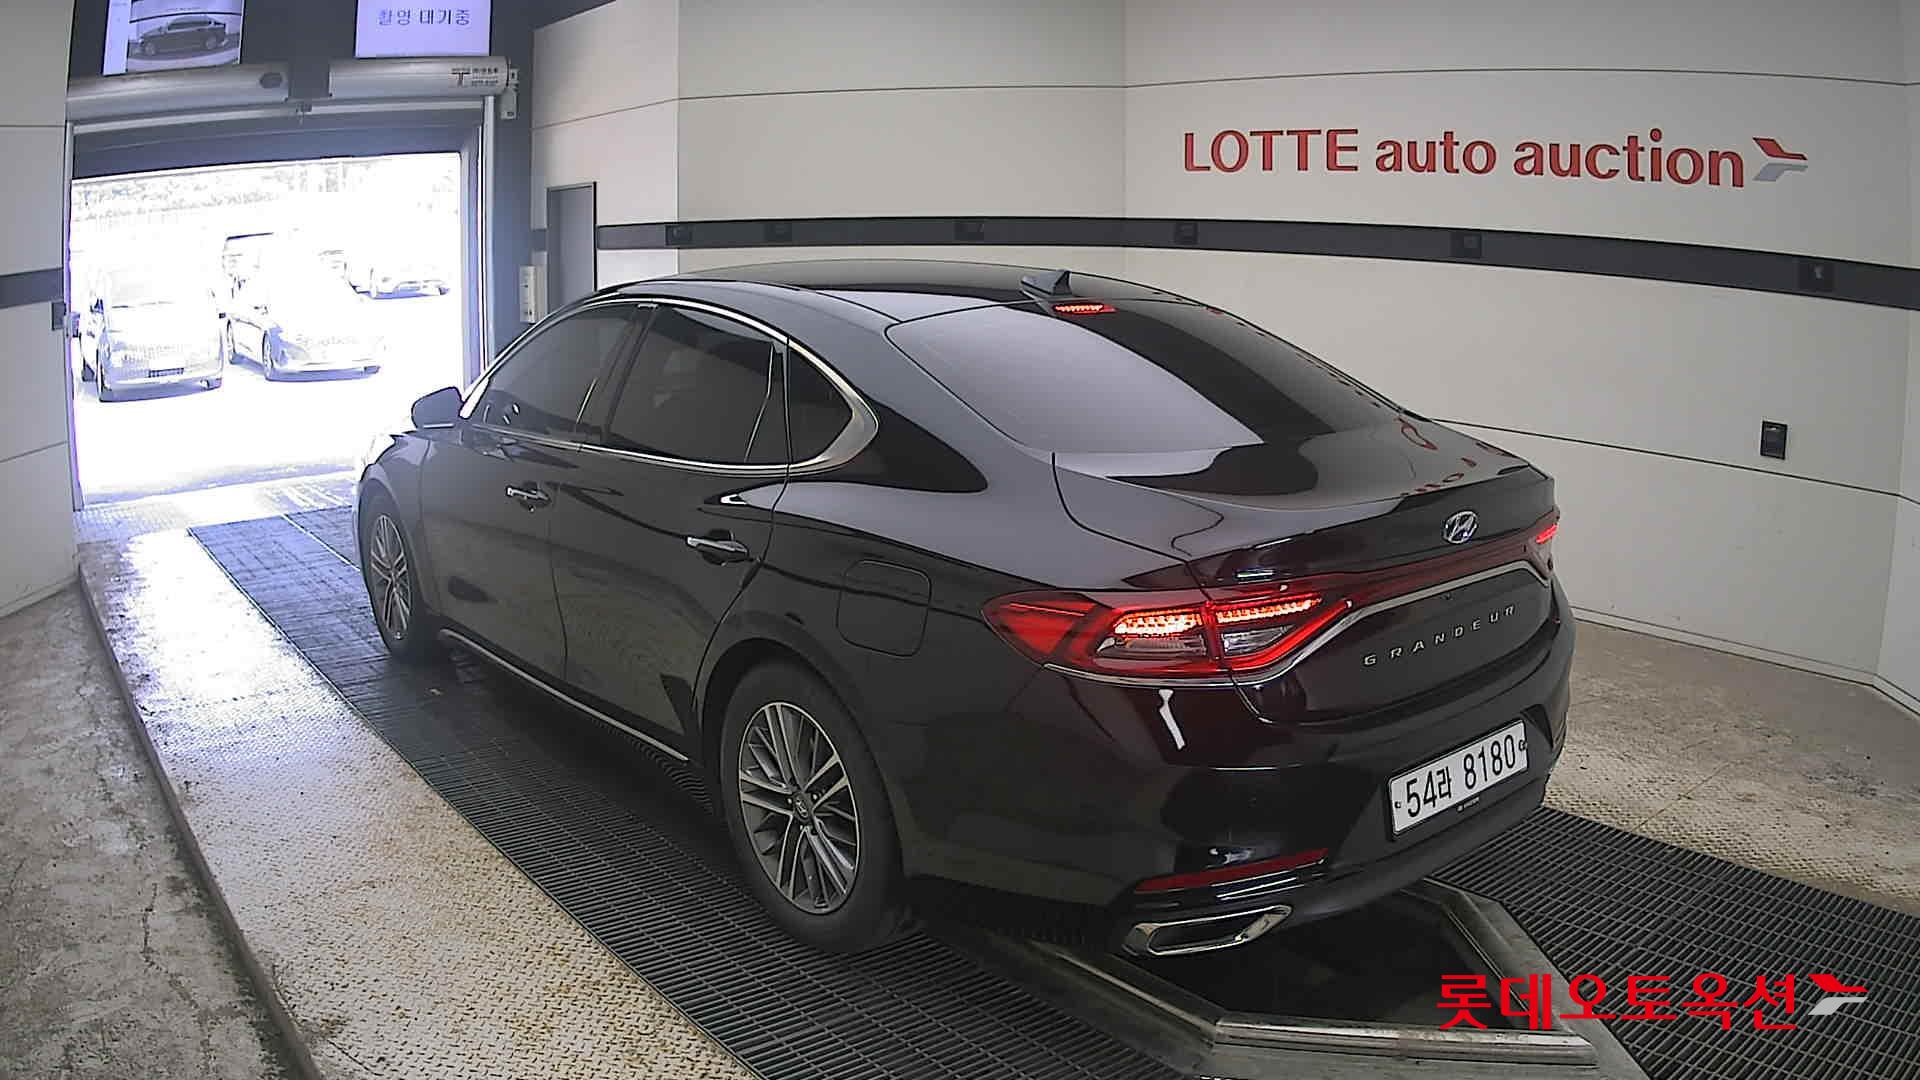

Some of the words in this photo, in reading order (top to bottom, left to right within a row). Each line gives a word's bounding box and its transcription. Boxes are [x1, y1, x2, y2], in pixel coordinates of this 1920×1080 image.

[419, 8, 470, 26] 대기중
[1184, 128, 1358, 173] LOTTE
[1375, 130, 1497, 174] auto
[1513, 127, 1744, 188] auction
[1363, 604, 1516, 666] GRANDEUR
[1405, 765, 1452, 818] 54라
[1463, 734, 1516, 790] 8180
